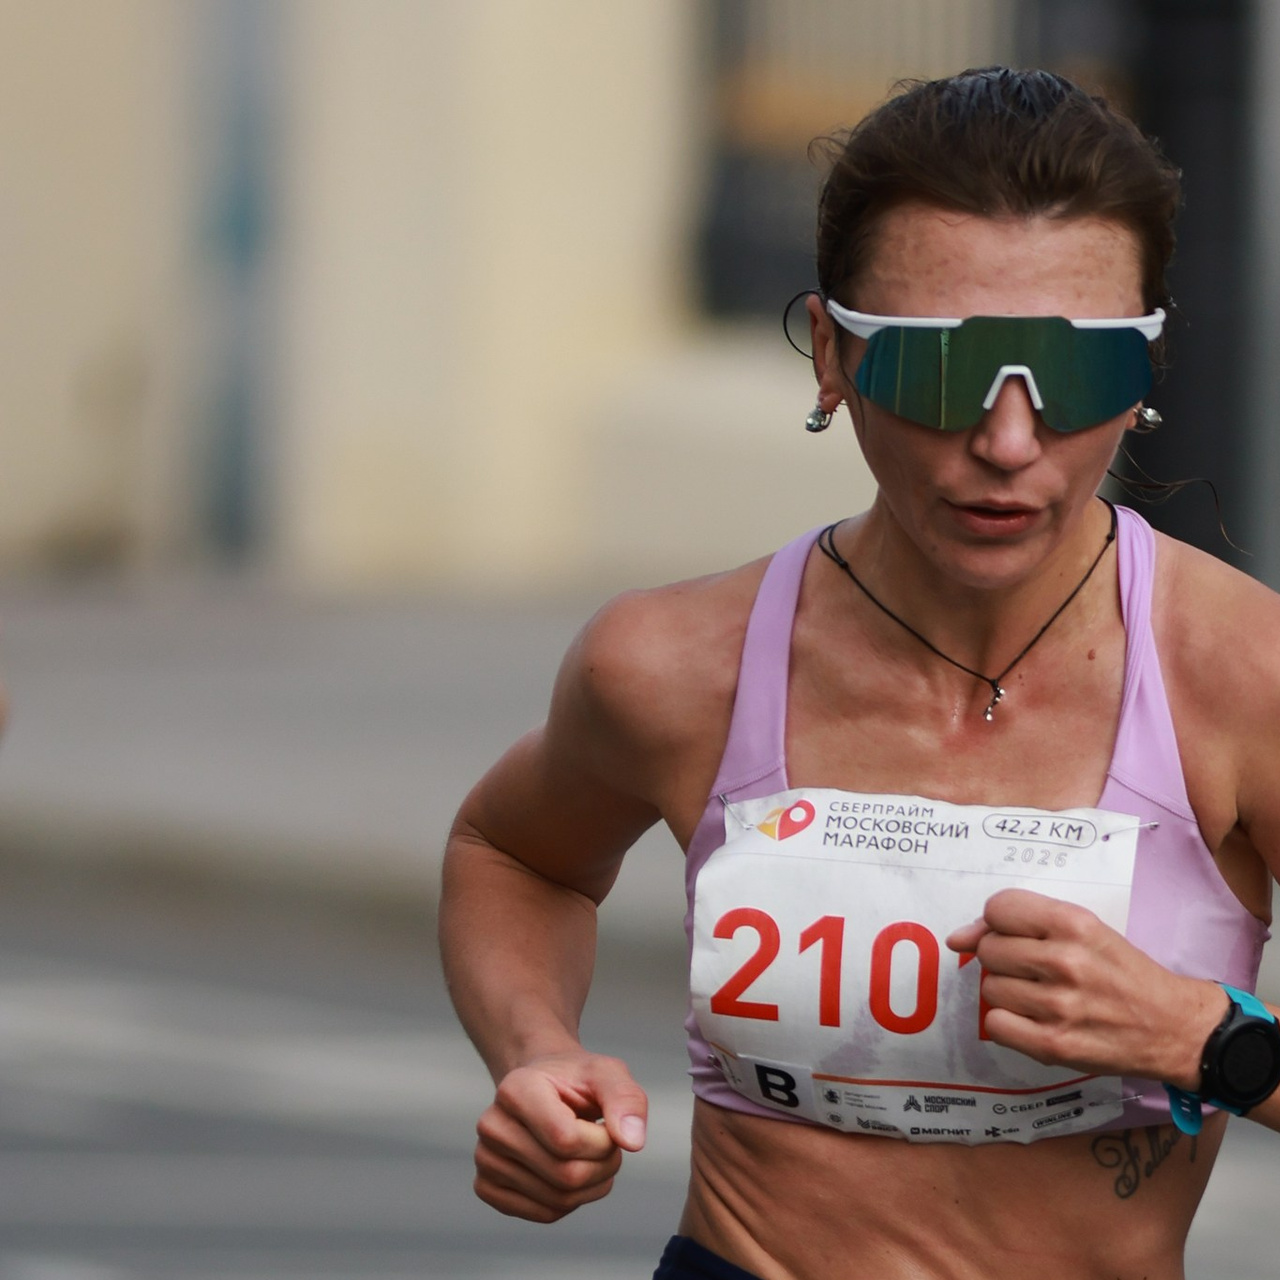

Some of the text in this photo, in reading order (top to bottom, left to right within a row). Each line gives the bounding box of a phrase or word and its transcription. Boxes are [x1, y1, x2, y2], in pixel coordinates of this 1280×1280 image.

[829, 801, 934, 818] СБЕРПРАЙМ
[825, 814, 969, 839] МОСКОВСКИЙ
[995, 819, 1083, 841] 42,2 КМ
[822, 832, 929, 854] МАРАФОН
[1003, 846, 1068, 868] 2026
[755, 1064, 800, 1108] B
[924, 1095, 977, 1108] МОСКОВСКИЙ
[924, 1104, 949, 1114] СПОРТ
[1010, 1101, 1044, 1113] СБЕР
[1036, 1110, 1073, 1127] WINLINE
